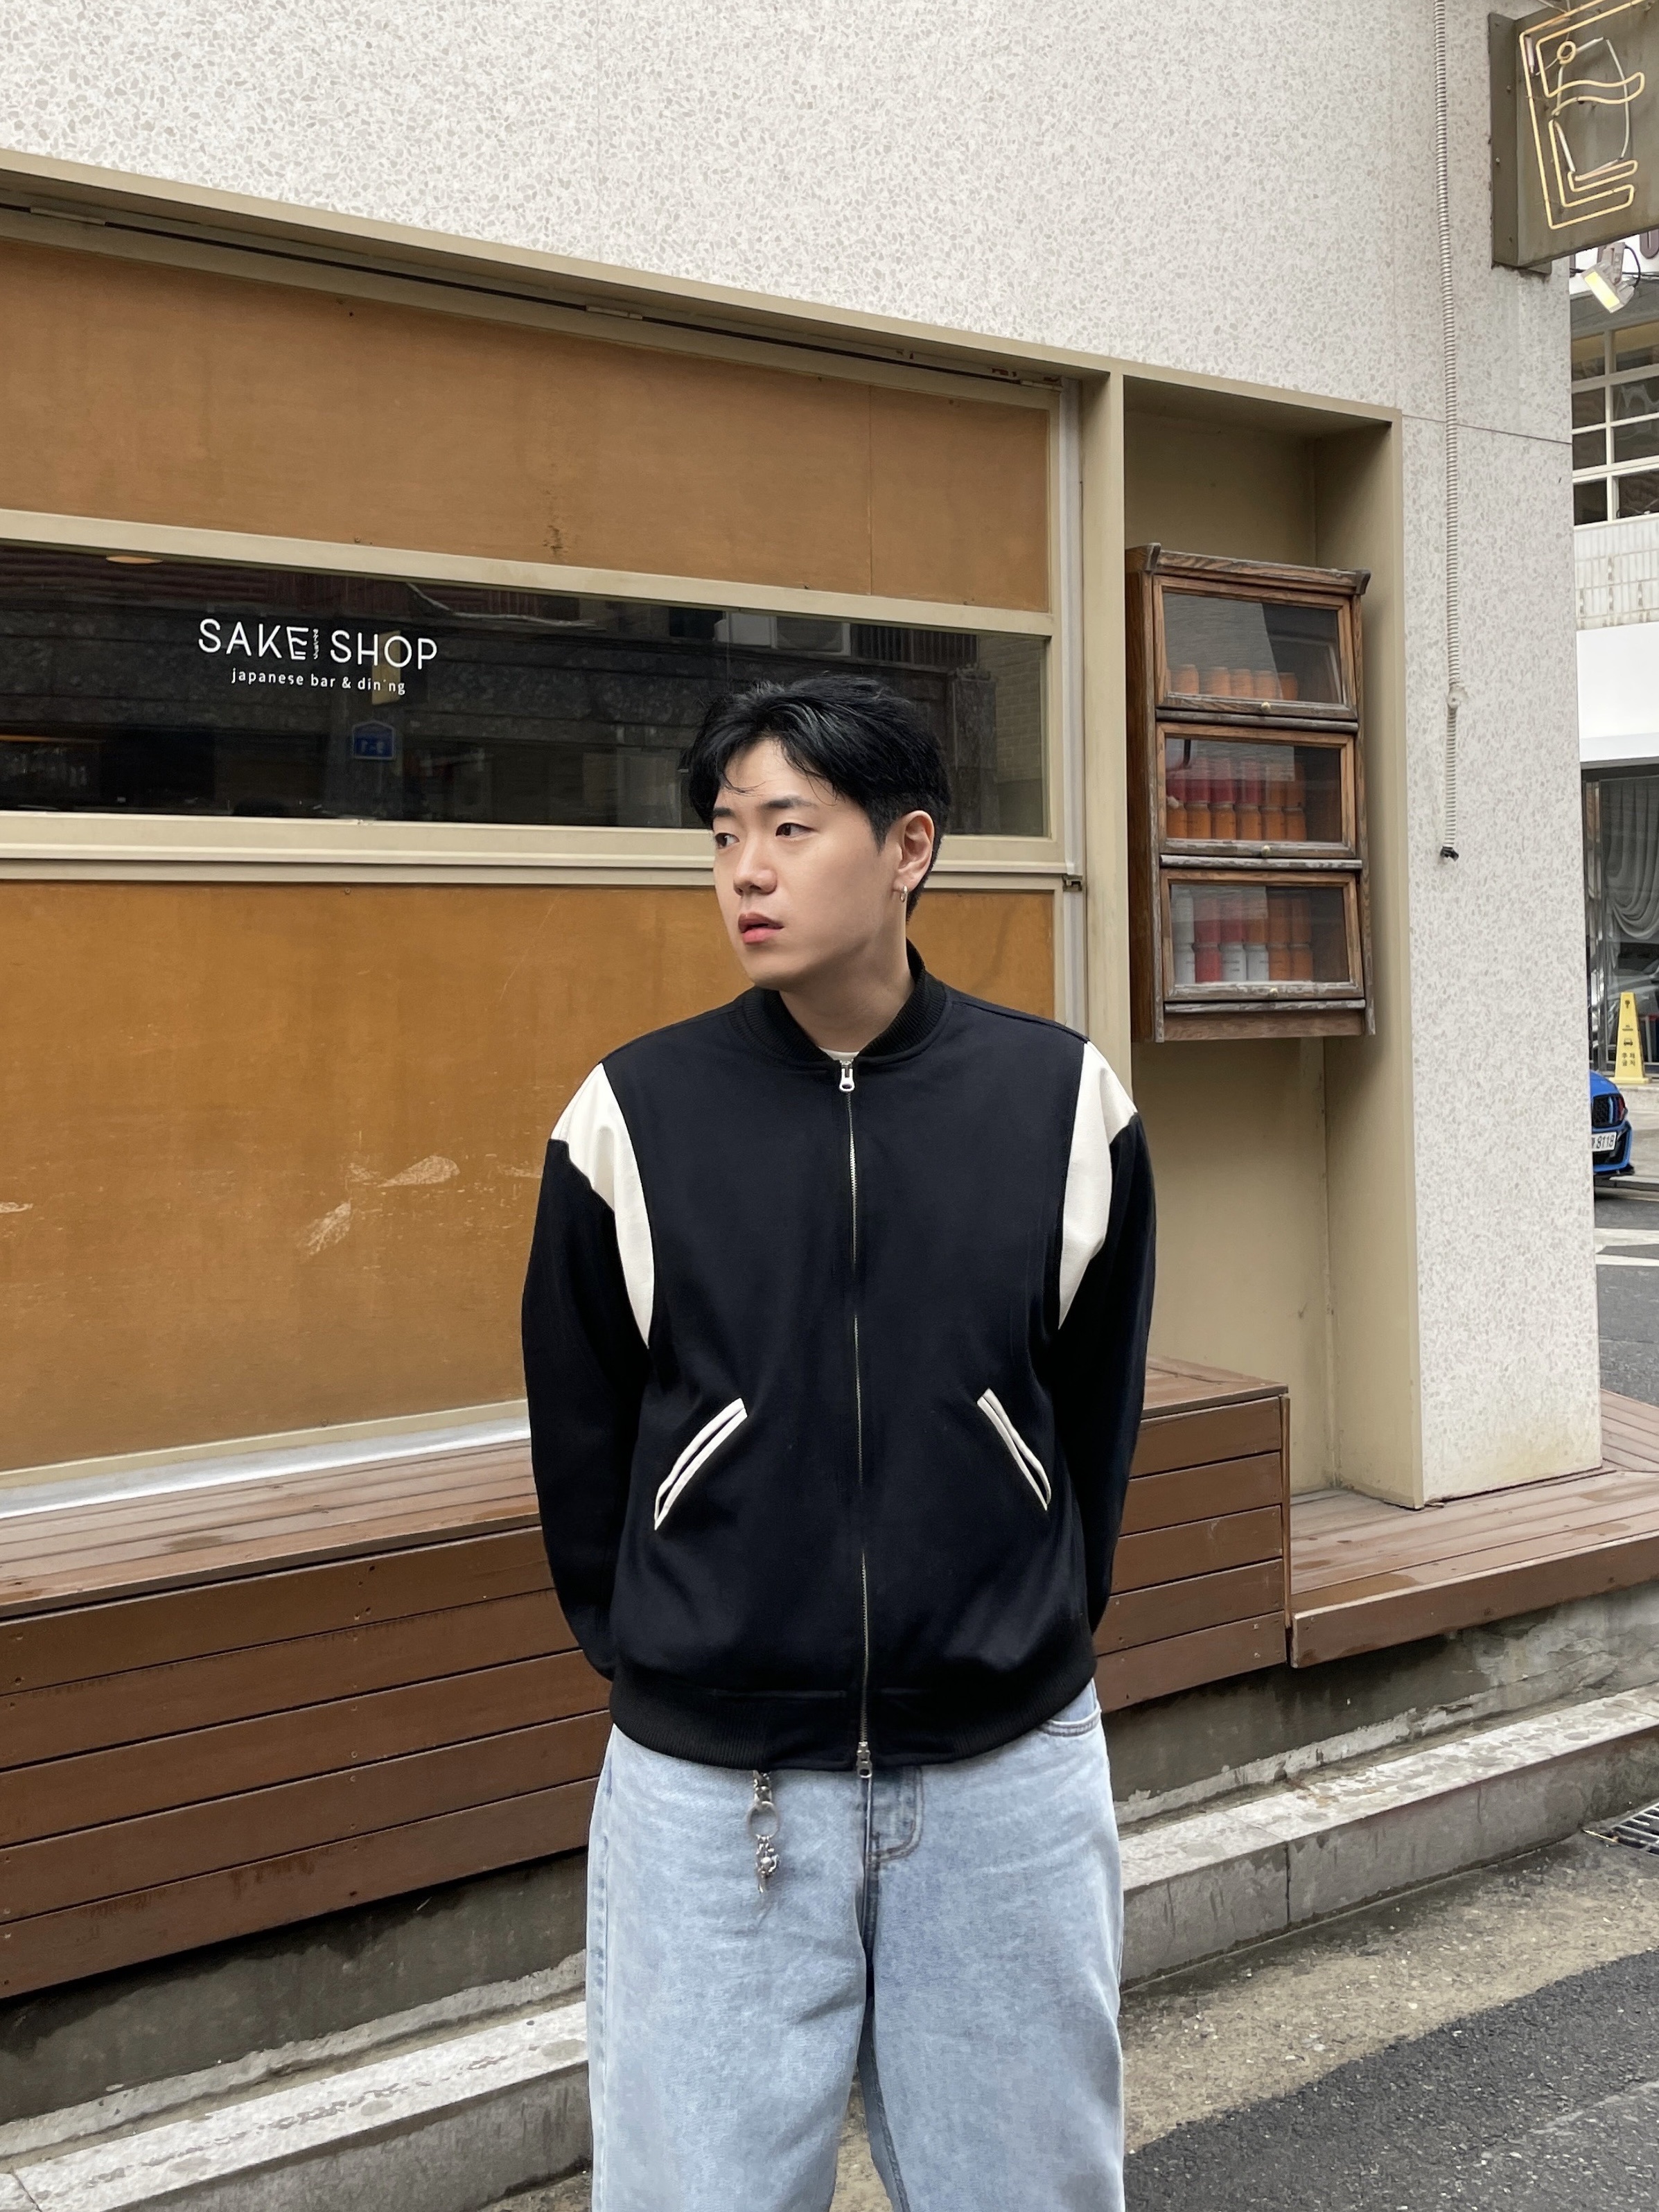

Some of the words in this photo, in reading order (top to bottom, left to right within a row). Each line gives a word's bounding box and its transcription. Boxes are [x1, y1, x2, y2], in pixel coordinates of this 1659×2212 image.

[198, 618, 310, 660] SAKE
[330, 629, 438, 670] SHOP
[231, 667, 304, 685] japanese
[310, 674, 336, 687] bar
[342, 677, 351, 690] &
[357, 676, 406, 696] dinng
